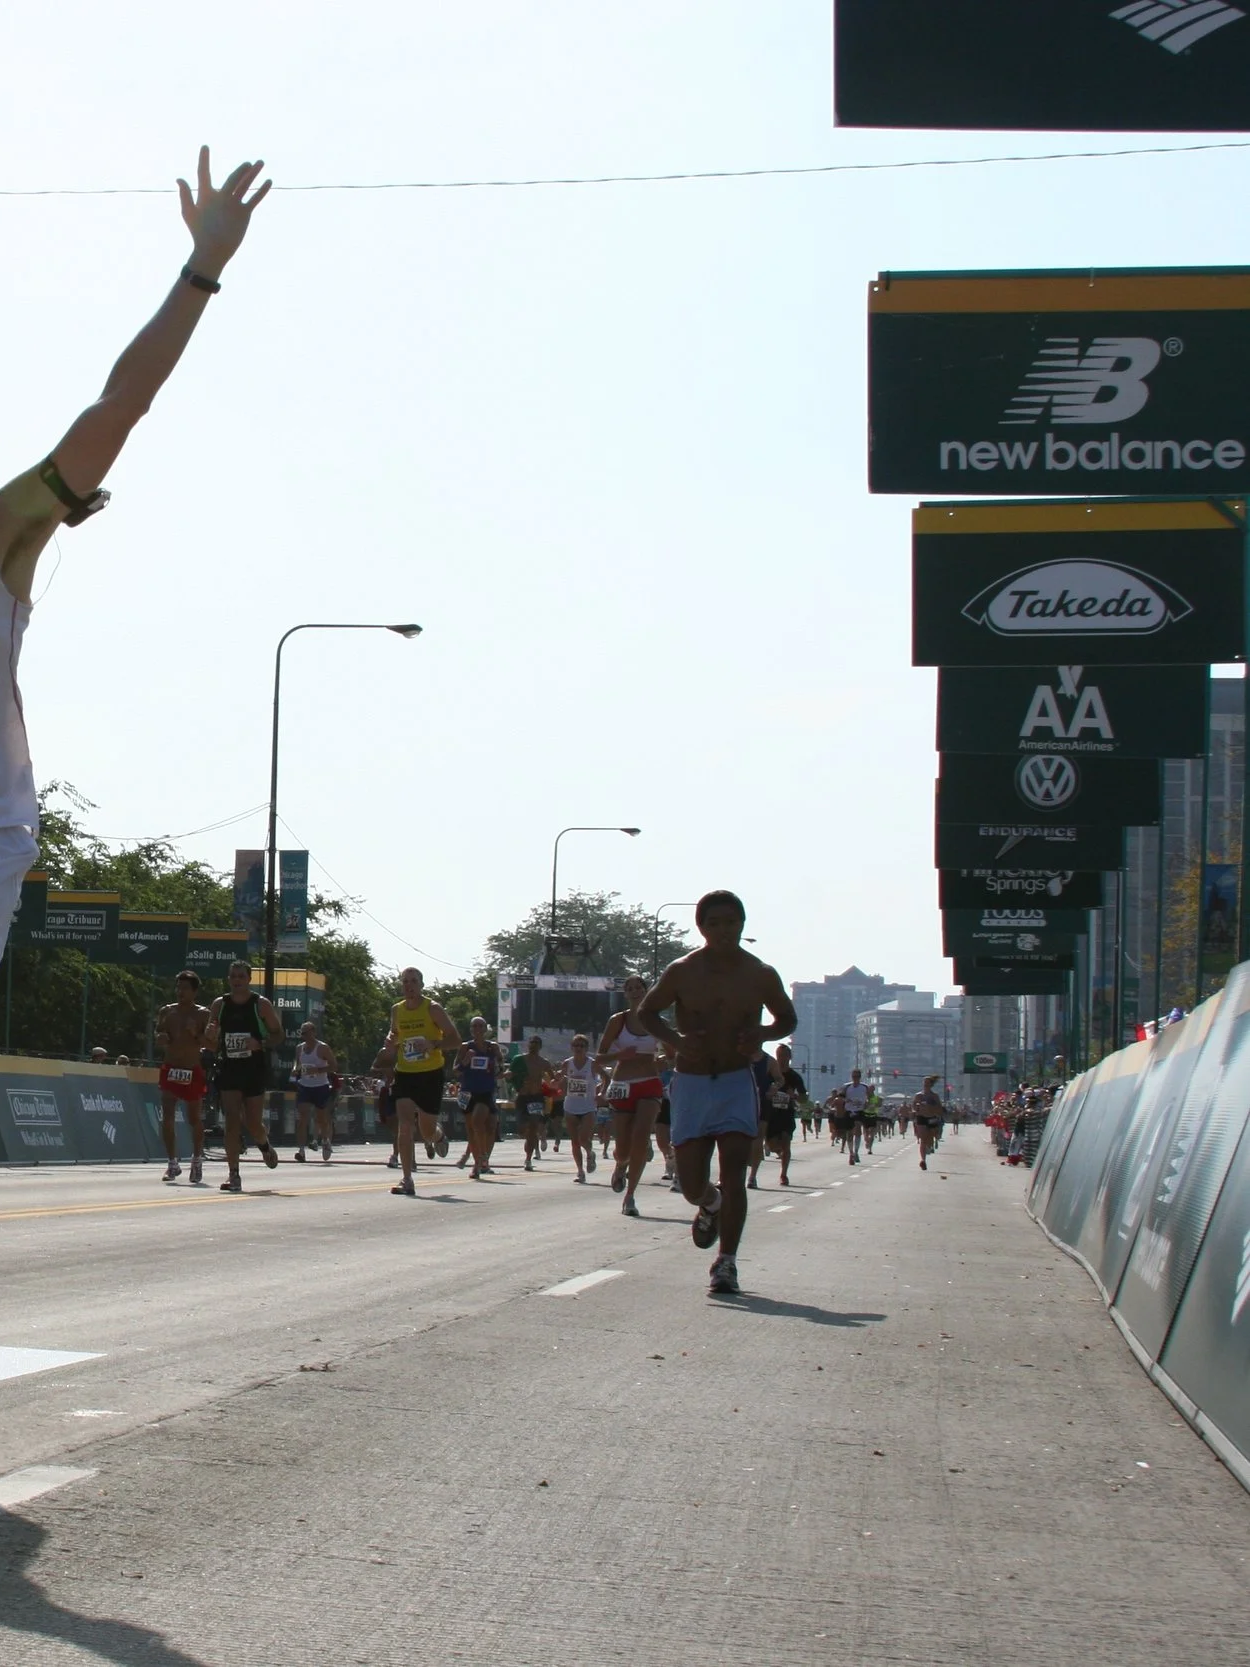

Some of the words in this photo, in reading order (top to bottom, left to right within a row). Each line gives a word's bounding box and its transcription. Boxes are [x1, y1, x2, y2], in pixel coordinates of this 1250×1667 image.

[940, 440, 1040, 470] new
[1045, 432, 1246, 470] balance
[1008, 589, 1155, 618] Takeda
[1019, 685, 1114, 738] AA
[1018, 739, 1114, 751] AmericanAirlines
[978, 826, 1077, 837] ENDURANCE
[985, 877, 1047, 895] Springs
[47, 917, 66, 926] cago
[67, 913, 102, 925] Tribune
[31, 931, 55, 940] What's
[57, 931, 64, 939] in
[72, 932, 82, 941] for
[84, 932, 101, 942] you?
[130, 931, 138, 941] of
[138, 931, 169, 942] America
[215, 951, 237, 961] Bank
[277, 997, 301, 1008] Bank
